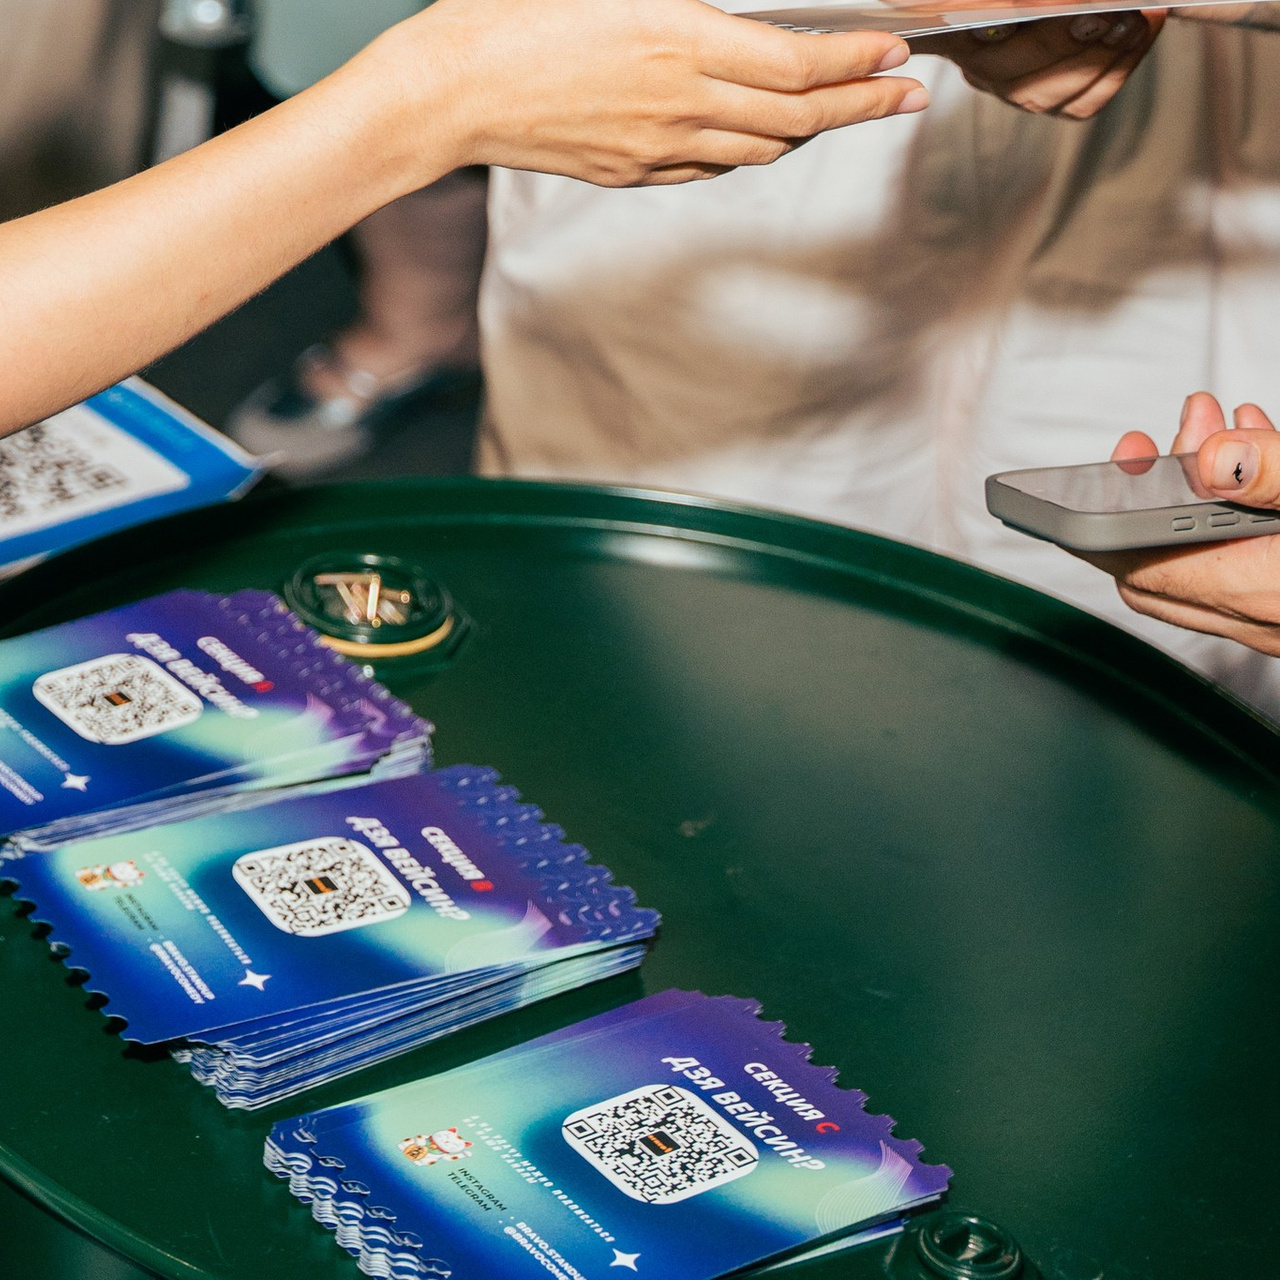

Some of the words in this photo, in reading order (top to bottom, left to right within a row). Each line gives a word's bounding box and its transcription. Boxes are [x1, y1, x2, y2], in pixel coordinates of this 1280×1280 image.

[660, 1056, 726, 1091] ДЗЯ
[711, 1091, 827, 1171] ВЕЙСИН?
[743, 1062, 826, 1121] СЕКЦИЯ
[447, 1171, 492, 1212] TELEGRAM
[458, 1167, 508, 1212] INSTAGRAM
